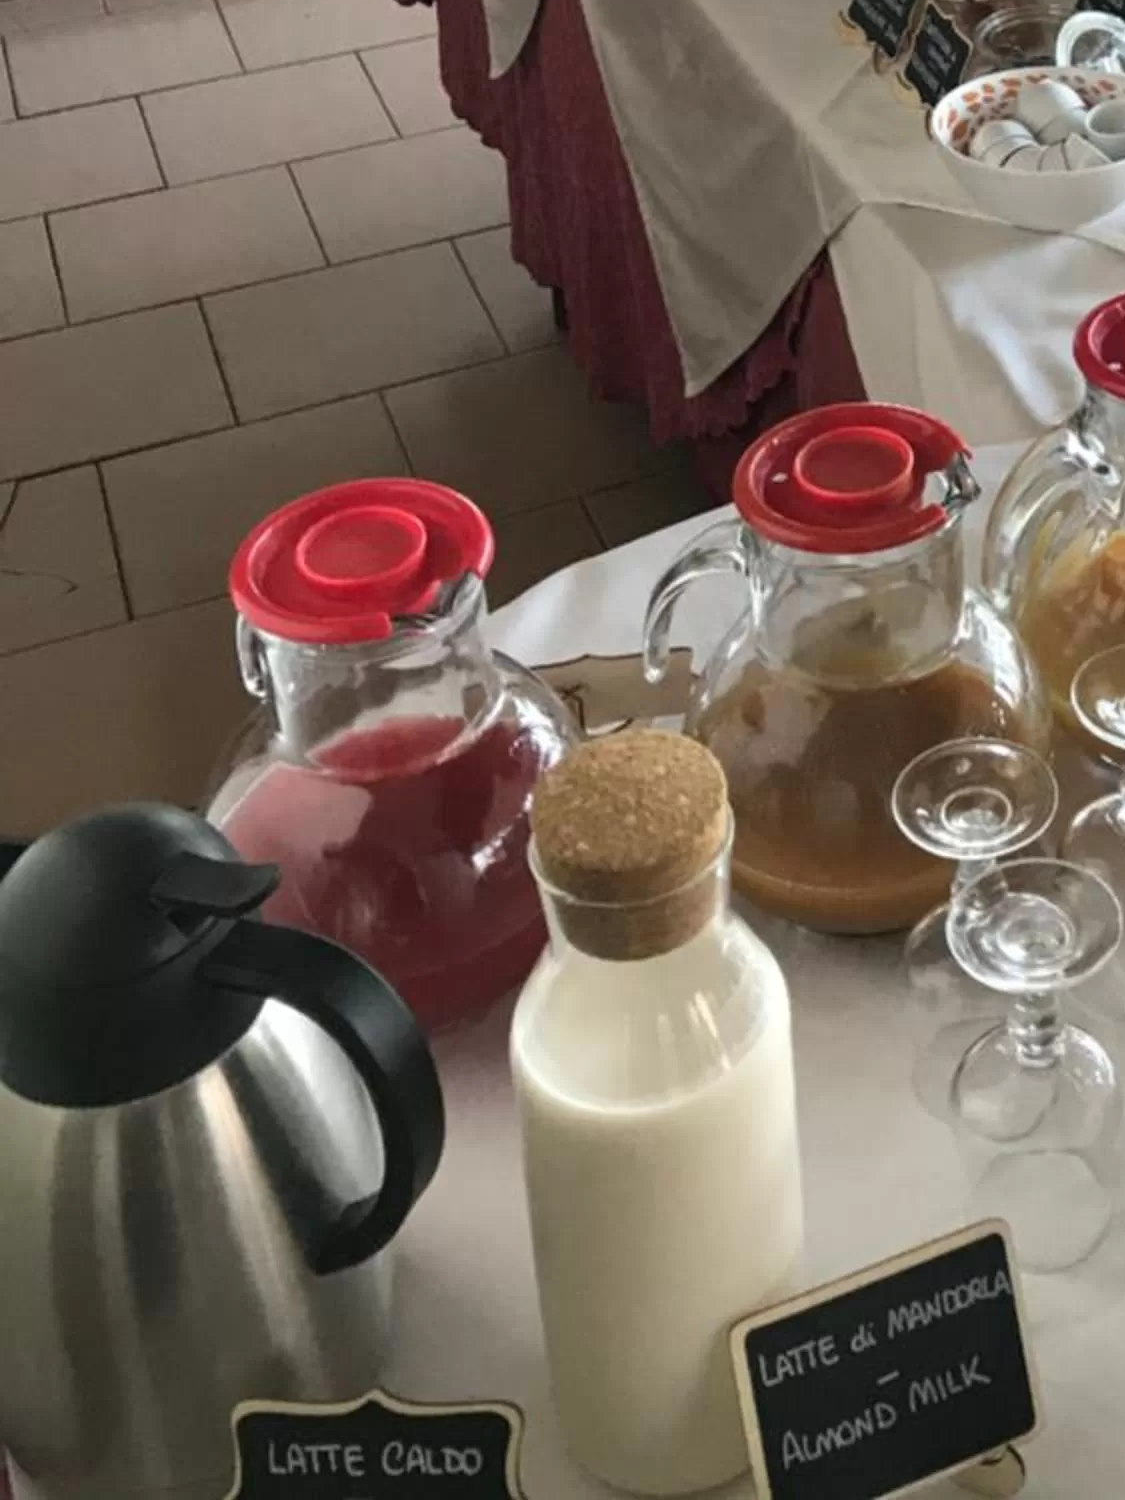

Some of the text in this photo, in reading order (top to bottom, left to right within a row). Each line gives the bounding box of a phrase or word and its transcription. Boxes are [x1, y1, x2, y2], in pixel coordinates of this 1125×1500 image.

[758, 1270, 1014, 1388] LATTE di MANDORLA
[268, 1440, 483, 1477] LATTE CALDO
[780, 1354, 992, 1470] ALMOND MILK
